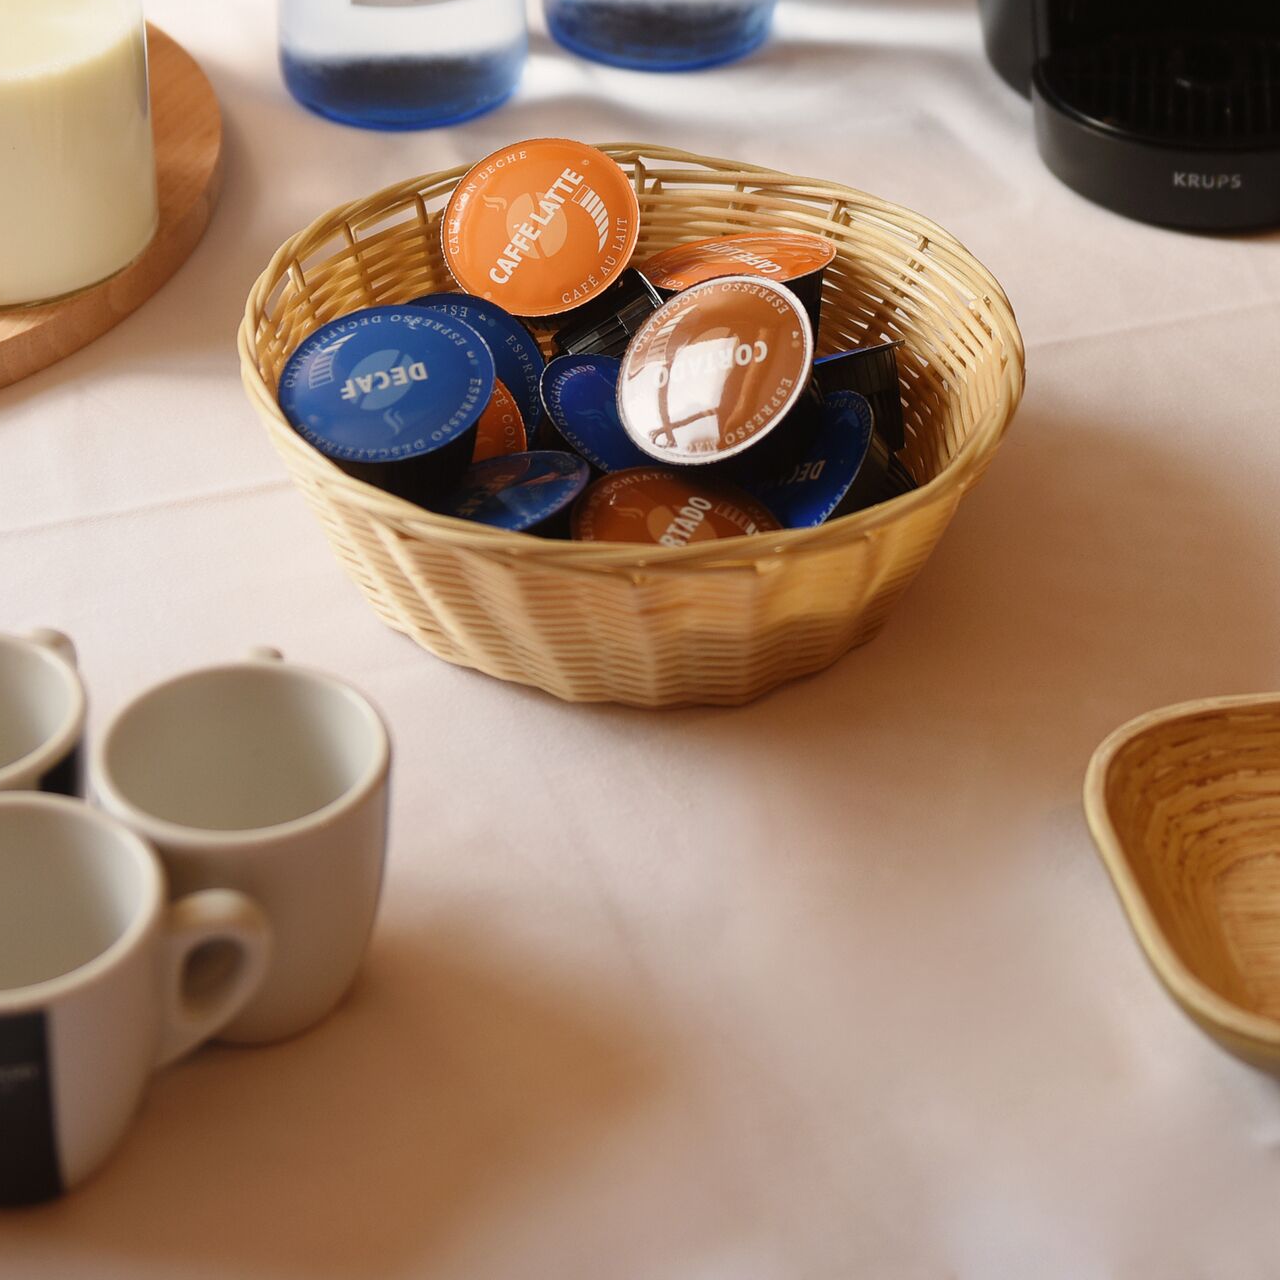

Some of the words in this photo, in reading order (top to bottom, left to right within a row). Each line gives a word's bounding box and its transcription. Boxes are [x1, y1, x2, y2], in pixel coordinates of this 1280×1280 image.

[454, 182, 478, 213] CON
[1173, 171, 1243, 189] KRUPS
[488, 221, 542, 285] CAFFÈ
[529, 166, 585, 227] LATTE
[561, 274, 600, 305] CAFÉ
[600, 255, 618, 277] AU
[612, 216, 629, 252] LAIT
[634, 284, 715, 353] MACCHIATO
[721, 282, 790, 315] ESPRESSO
[390, 313, 468, 348] ESPRESSO
[339, 361, 429, 401] DECAF
[505, 333, 540, 417] ESPRESSO
[431, 377, 483, 442] ESPRESSO
[724, 377, 793, 446] ESPRESSO
[658, 495, 713, 548] RTADO
